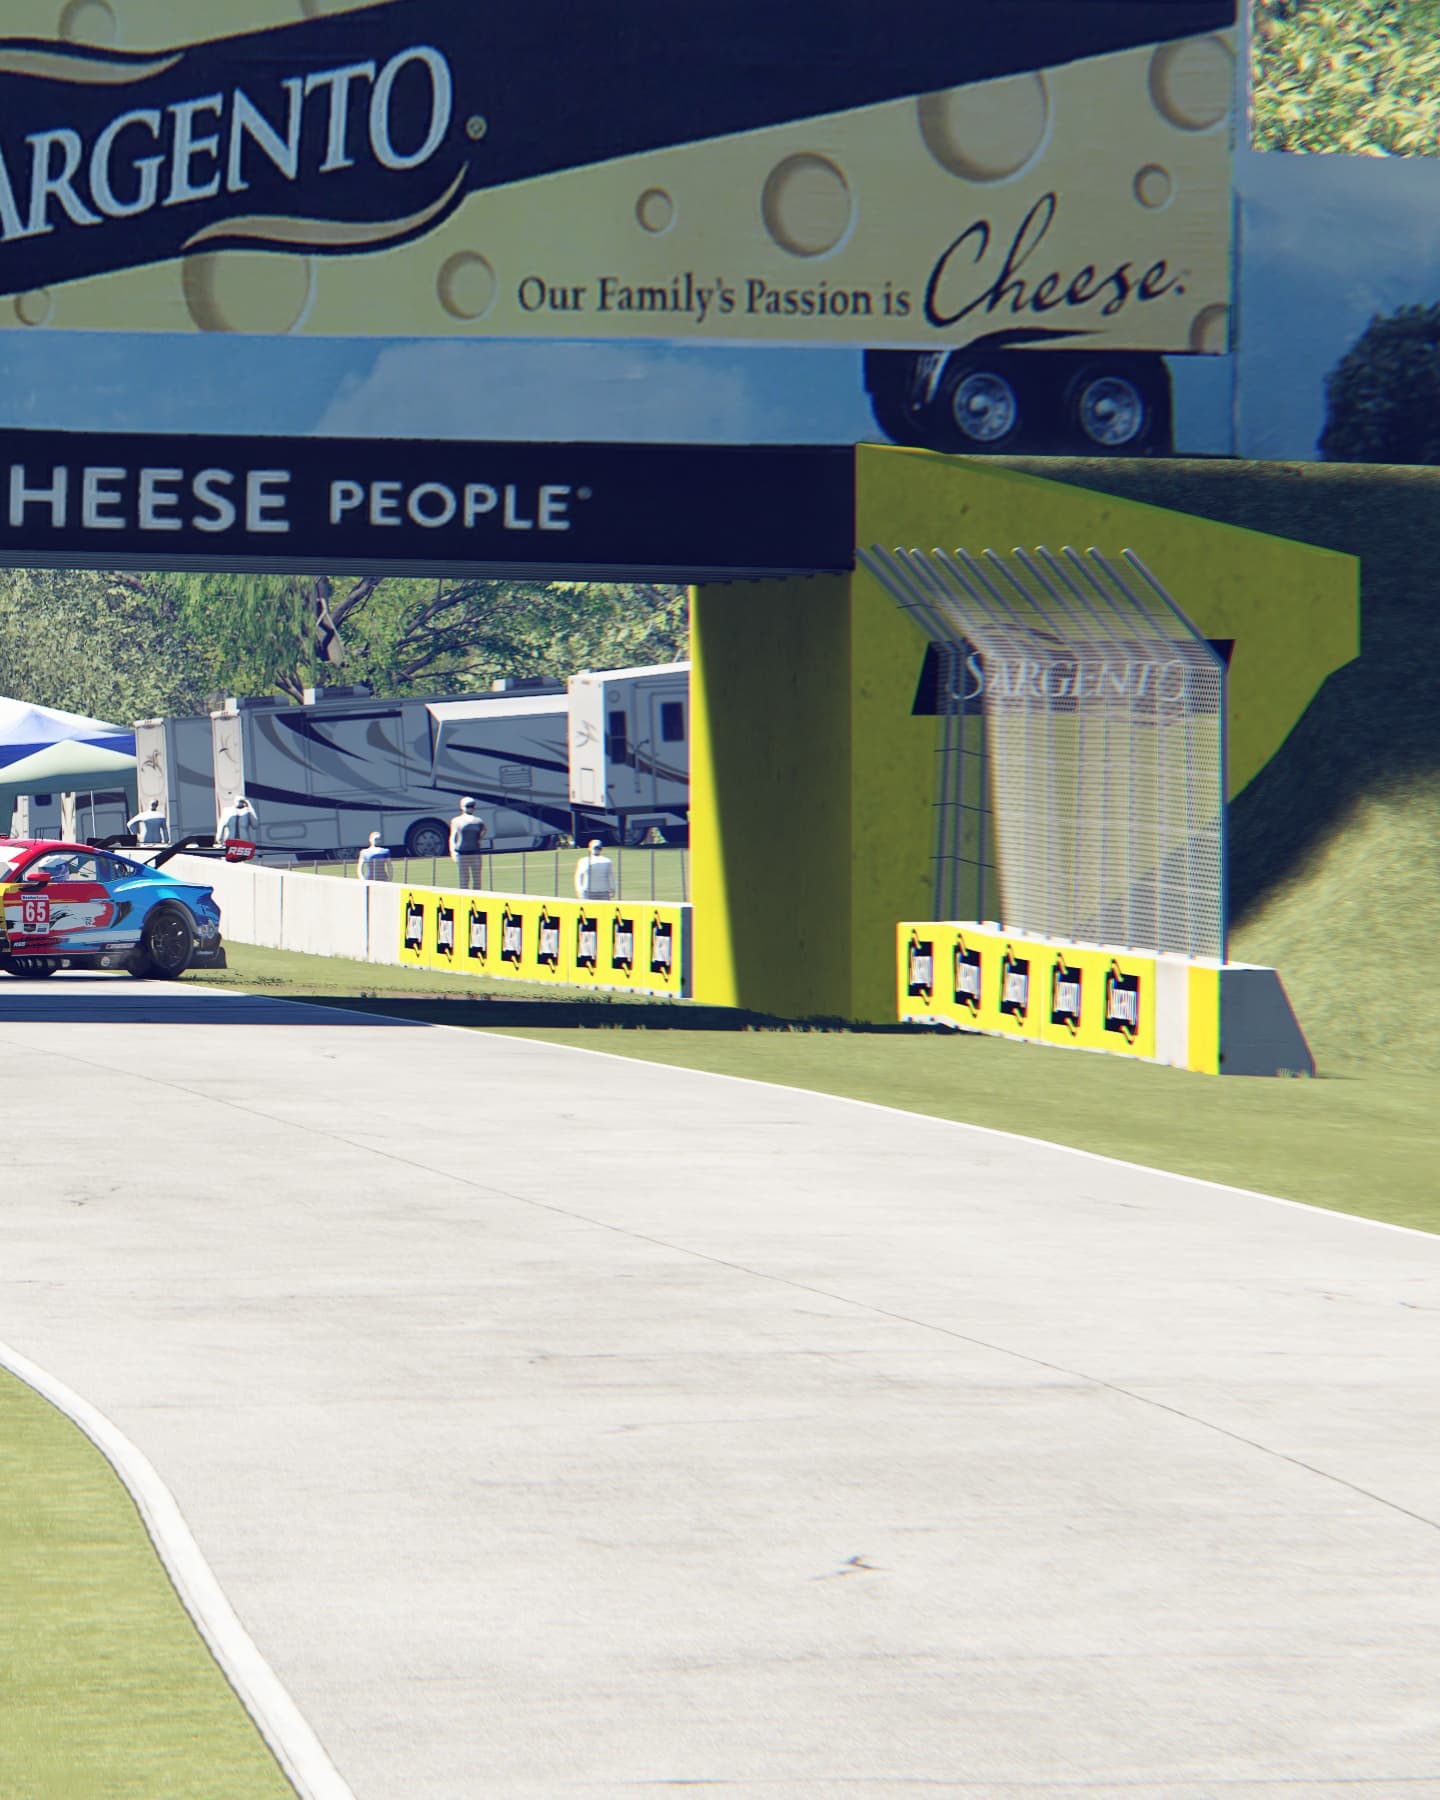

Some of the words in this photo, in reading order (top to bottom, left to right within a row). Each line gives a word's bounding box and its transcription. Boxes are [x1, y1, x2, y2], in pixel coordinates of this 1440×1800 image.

[517, 277, 584, 313] Our
[596, 272, 736, 323] Family's
[745, 278, 875, 316] Passion
[882, 282, 911, 316] is
[329, 480, 571, 530] PEOPLE
[228, 846, 252, 856] RSS
[25, 901, 47, 922] 65
